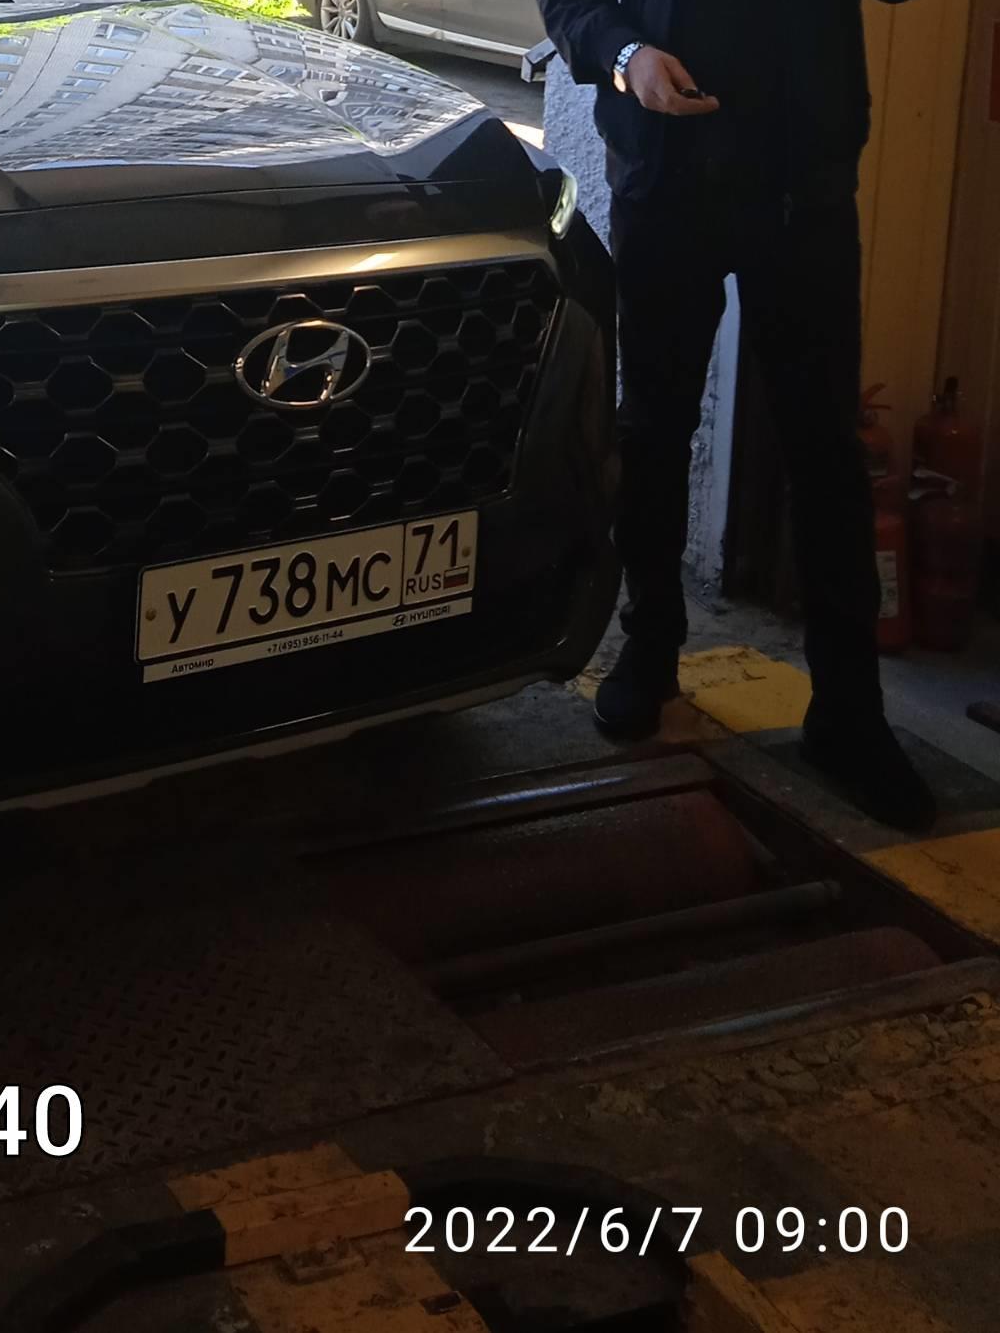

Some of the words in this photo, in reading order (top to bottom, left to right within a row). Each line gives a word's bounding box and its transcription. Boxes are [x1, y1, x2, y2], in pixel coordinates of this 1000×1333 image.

[411, 519, 459, 576] 71
[405, 573, 444, 596] RUS
[410, 605, 451, 623] HYUNDAI
